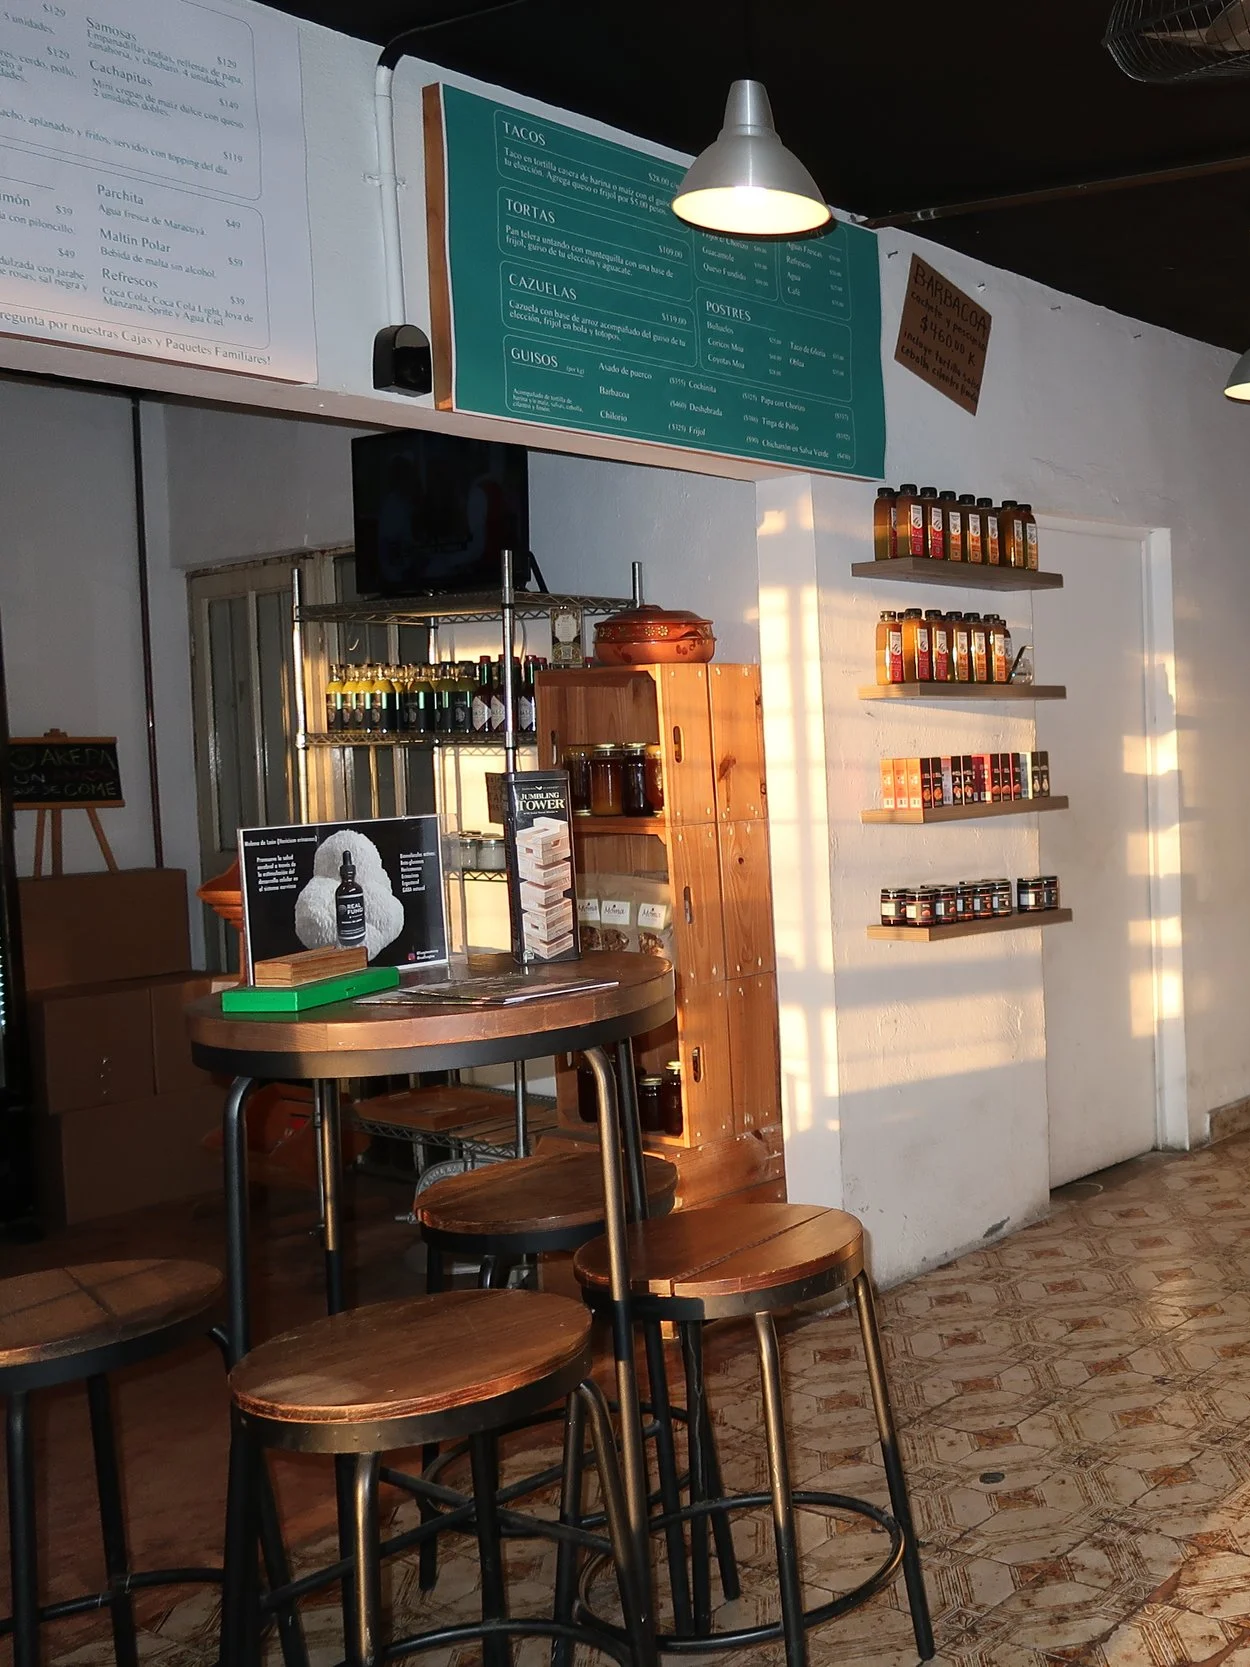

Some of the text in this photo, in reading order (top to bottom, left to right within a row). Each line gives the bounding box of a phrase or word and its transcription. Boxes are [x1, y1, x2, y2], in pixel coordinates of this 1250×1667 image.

[86, 16, 137, 41] Samosas
[217, 56, 237, 69] $129
[89, 59, 153, 87] Cachapitas
[203, 113, 219, 122] con
[502, 120, 546, 146] TACOS
[168, 152, 200, 170] topping
[504, 147, 648, 199] Taco en tortilla casera de harina con
[504, 158, 512, 166] tu
[546, 171, 571, 188] Agrega
[572, 181, 592, 193] queso
[600, 188, 617, 203] frijol
[617, 194, 629, 204] por
[97, 184, 144, 205] Parchita
[9, 215, 26, 224] con
[56, 205, 73, 216] $39
[99, 203, 162, 226] Agua fresca de
[506, 198, 555, 224] TORTAS
[225, 218, 241, 229] $49
[58, 247, 76, 259] $49
[141, 236, 172, 253] Polar
[505, 225, 665, 276] Pan telera untando con mantequilla con base
[100, 246, 169, 269] Bebida de malta
[228, 256, 243, 267] $59
[527, 242, 547, 254] guiso
[548, 246, 557, 257] de
[566, 251, 596, 267] elección
[702, 246, 735, 262] Guacamole
[37, 265, 55, 275] con
[102, 267, 159, 288] Refrescos
[702, 262, 747, 281] Queso Fundido
[509, 273, 577, 301] CAZUELAS
[102, 285, 125, 298] Coca
[152, 295, 175, 308] Coca
[176, 299, 196, 312] Cola
[244, 313, 254, 323] de
[913, 263, 988, 339] BARBACOA
[149, 304, 173, 318] Sprite
[184, 311, 205, 324] Agua
[706, 300, 752, 322] POSTRES
[509, 299, 679, 345] Cazuela con base de arroz acompañado del guiso de
[543, 315, 561, 330] frijol
[562, 321, 572, 330] en
[572, 322, 588, 334] bola
[48, 319, 69, 331] por
[72, 323, 119, 340] nuestras
[121, 330, 152, 346] Cajas
[165, 337, 213, 355] Paquetes
[215, 346, 271, 366] Familiares!
[511, 347, 558, 368] GUISOS
[707, 353, 731, 366] Coyotas
[598, 362, 652, 380] Asado de puerco
[599, 386, 630, 399] Barbacoa
[688, 380, 717, 393] Cochinita
[600, 409, 628, 423] Chilorio
[689, 402, 724, 417] Deshebrada
[688, 426, 706, 438] Frijol
[762, 417, 777, 429] Tinga
[785, 421, 800, 432] Pollo
[799, 446, 813, 456] Salsa
[813, 448, 829, 458] Verde
[64, 781, 117, 797] COME
[520, 791, 560, 801] JUMBLING
[518, 798, 565, 812] TOWER
